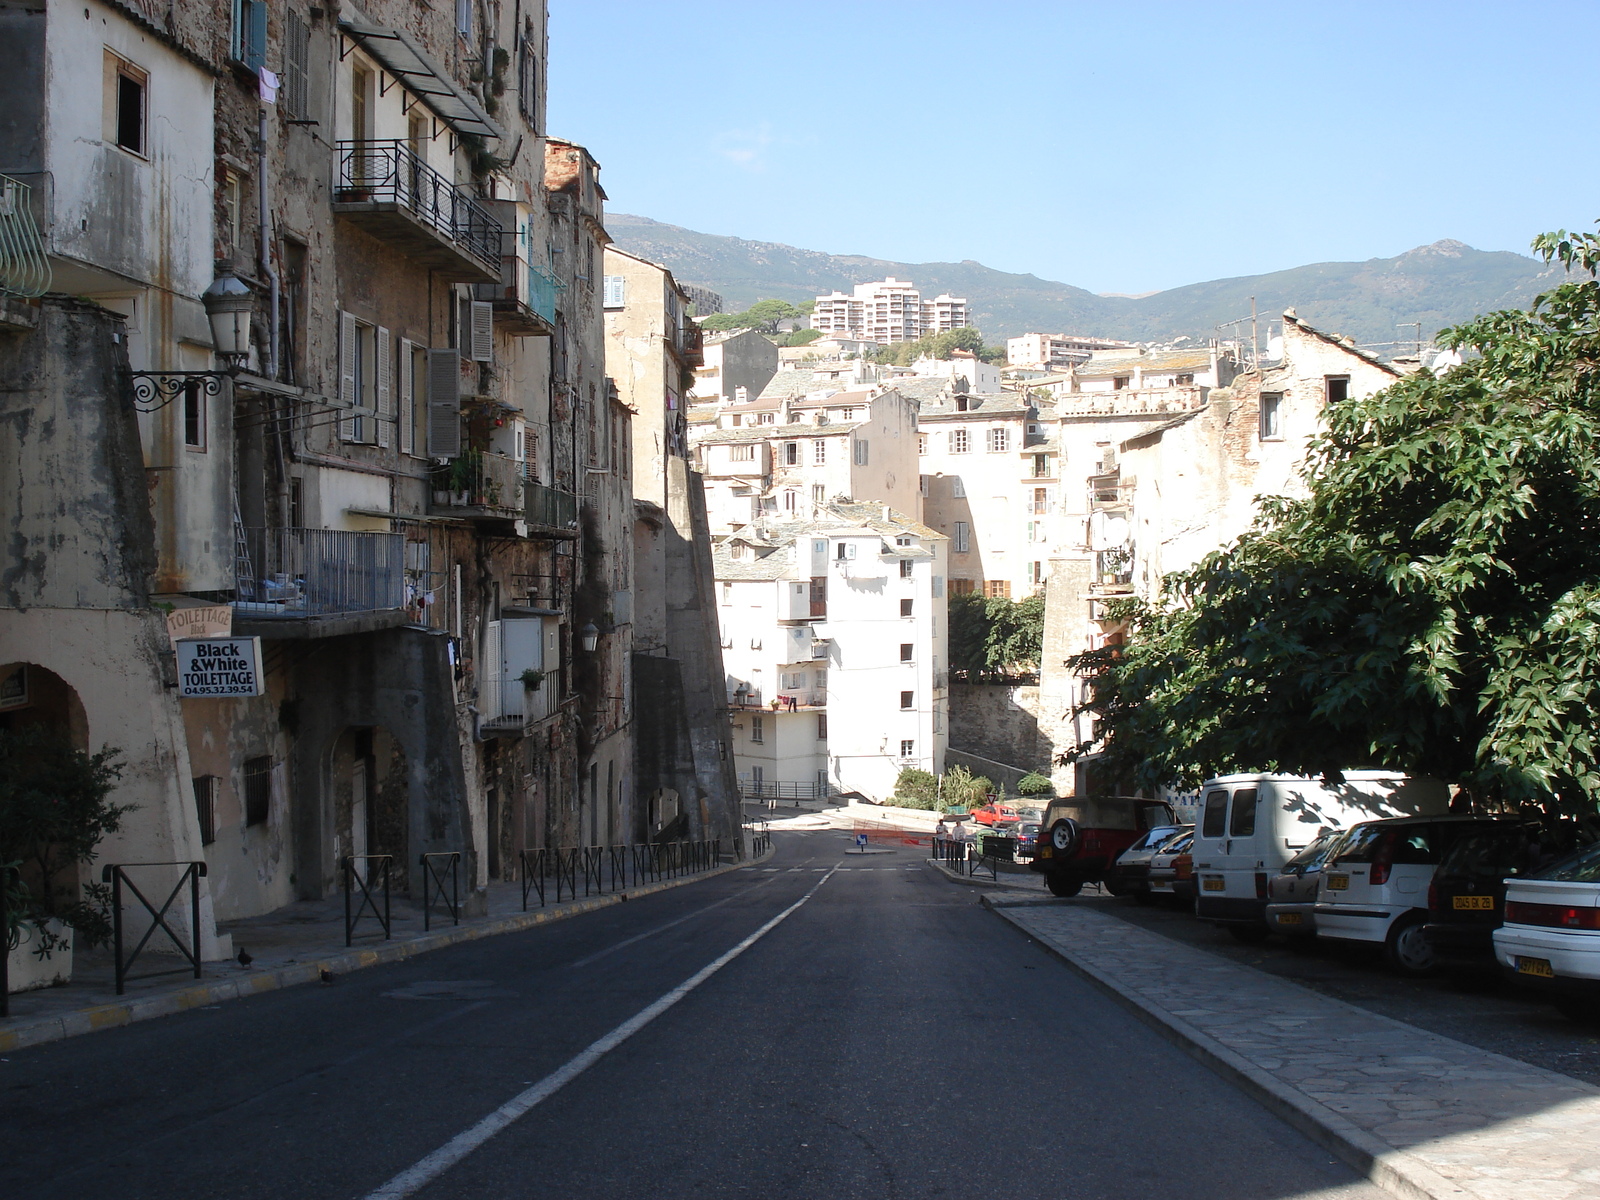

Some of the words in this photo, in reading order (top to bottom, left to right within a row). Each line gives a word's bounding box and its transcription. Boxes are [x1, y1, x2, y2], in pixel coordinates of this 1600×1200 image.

[169, 608, 231, 630] TOILETTAGE
[190, 623, 206, 635] Black
[196, 643, 240, 657] Black
[190, 657, 248, 671] &White
[183, 672, 253, 686] TOILETTAGE
[184, 685, 253, 695] 04.95.32.39.54
[1455, 897, 1470, 908] 2045
